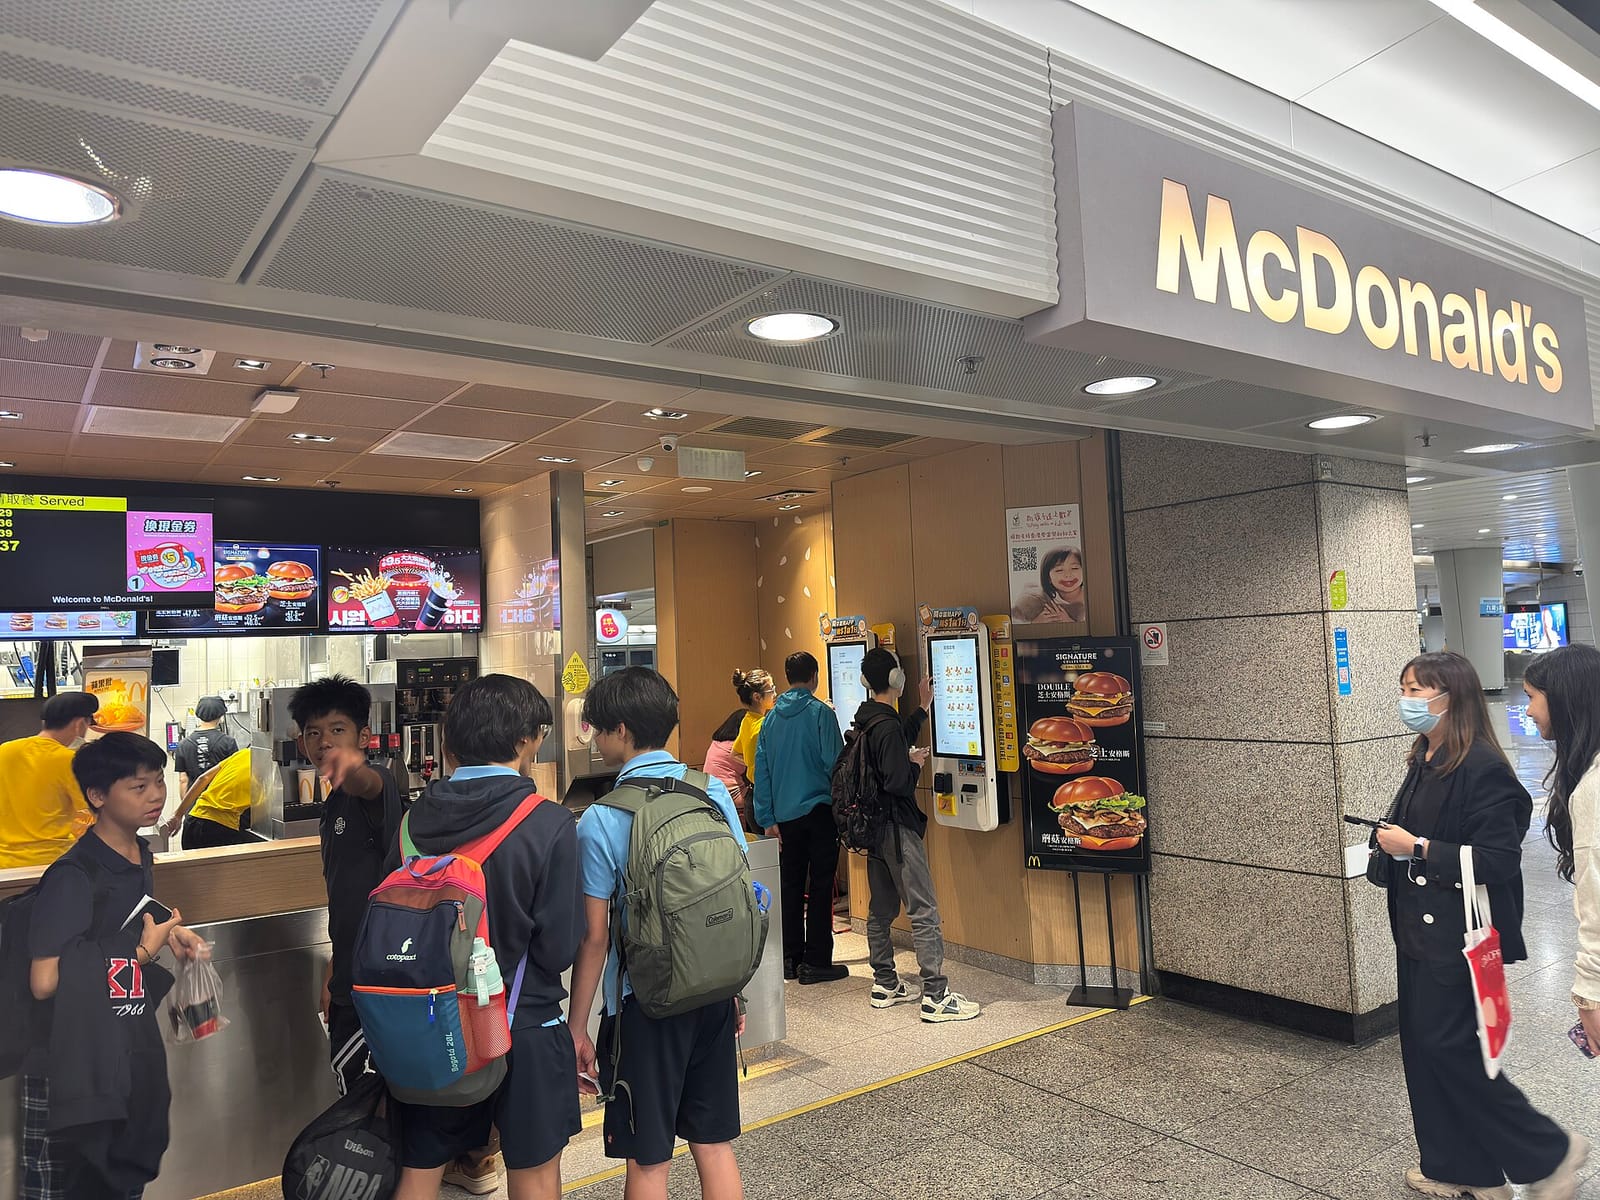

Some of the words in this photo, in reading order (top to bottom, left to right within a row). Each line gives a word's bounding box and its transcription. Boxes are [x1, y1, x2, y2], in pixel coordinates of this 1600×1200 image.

[1155, 176, 1564, 394] McDonald's
[40, 496, 85, 506] Served
[144, 519, 197, 533] 換現金券
[0, 540, 20, 551] 37
[132, 577, 139, 590] 1
[52, 595, 91, 603] Welcome
[103, 595, 153, 603] McDonald's!
[329, 610, 366, 626] 시원
[443, 609, 480, 624] 하다
[1037, 683, 1070, 691] DOUBLE
[1037, 691, 1070, 699] 芝士安格斯
[1089, 747, 1130, 758] 芝士安格斯
[1041, 833, 1082, 845] 蘑菇安格斯
[317, 1163, 383, 1200] NBA
